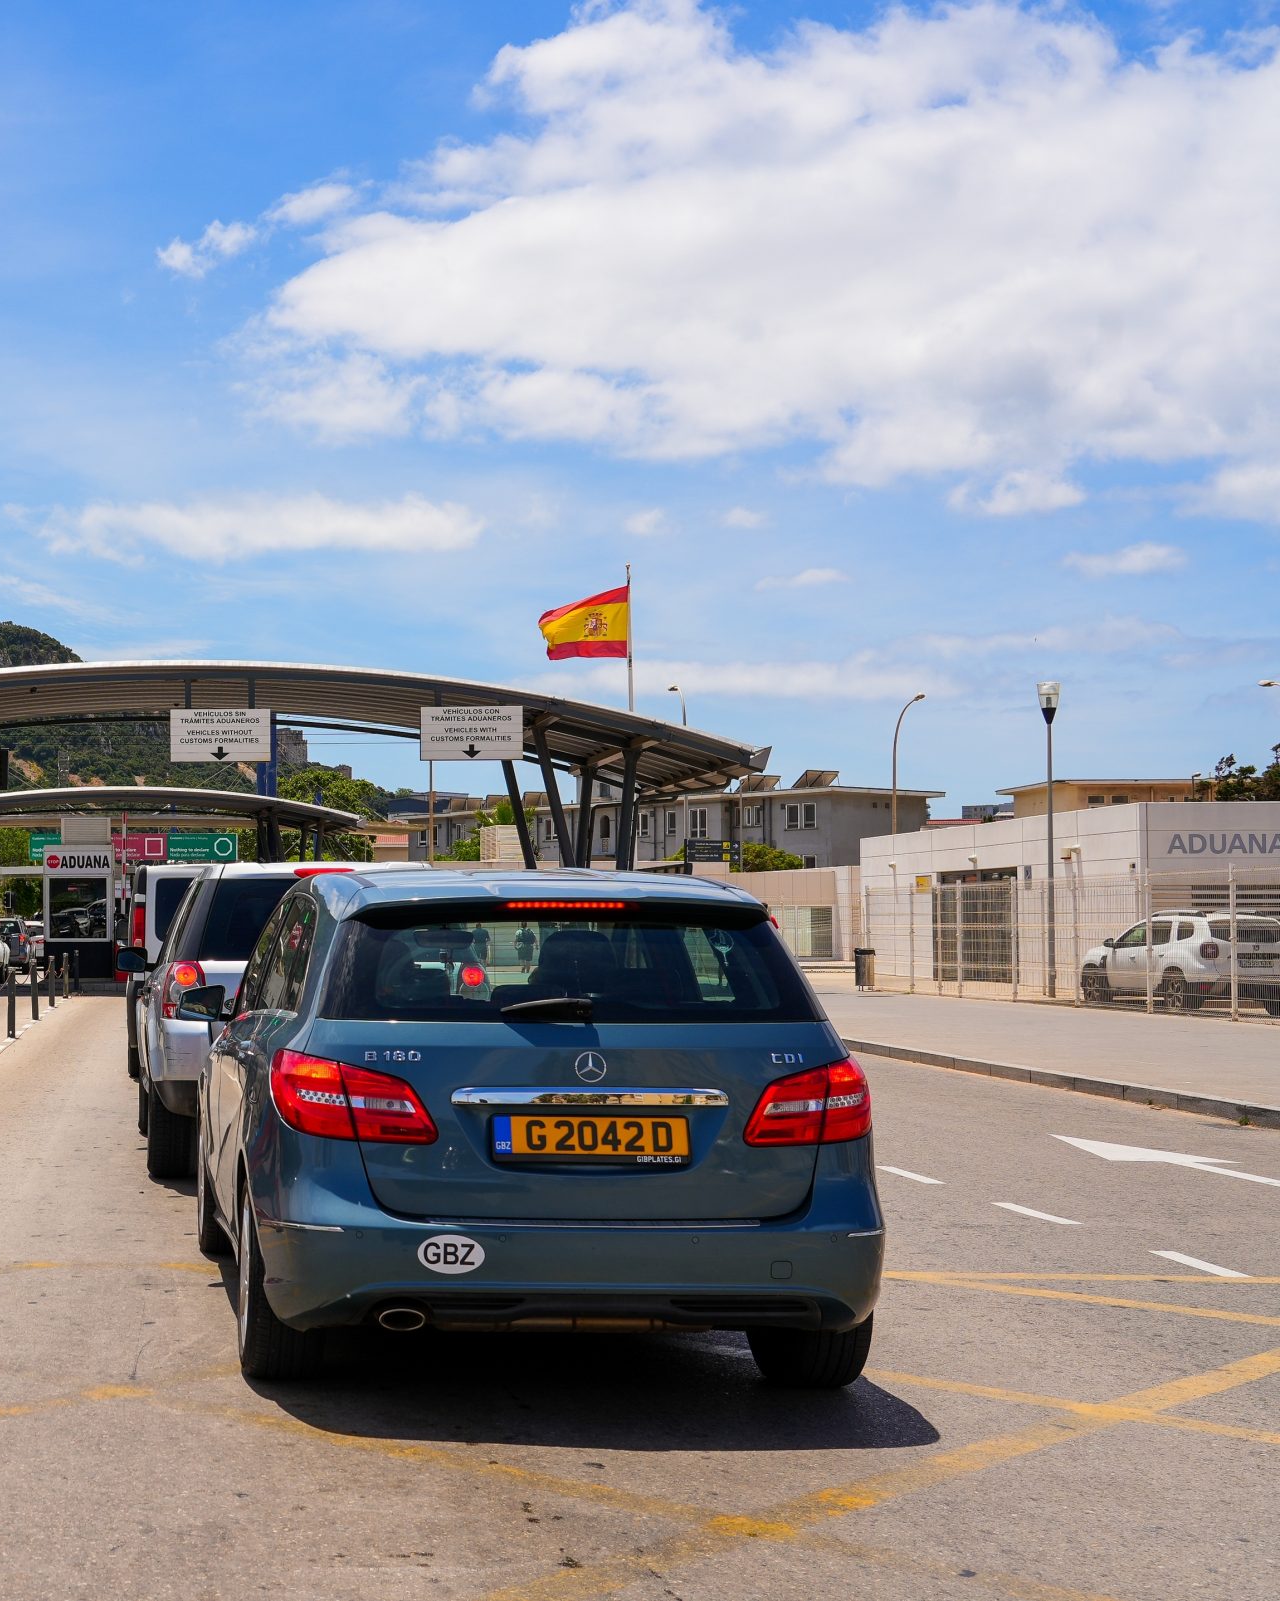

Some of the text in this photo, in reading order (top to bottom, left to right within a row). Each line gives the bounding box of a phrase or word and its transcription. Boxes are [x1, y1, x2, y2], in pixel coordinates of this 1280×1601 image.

[1167, 833, 1280, 855] ADUANA
[60, 855, 110, 869] ADUANA
[364, 1050, 422, 1062] B 180
[771, 1053, 804, 1064] CDI
[495, 1141, 512, 1151] GBZ
[636, 1155, 682, 1164] GIBPLATES.GI
[423, 1242, 475, 1266] GBZ
